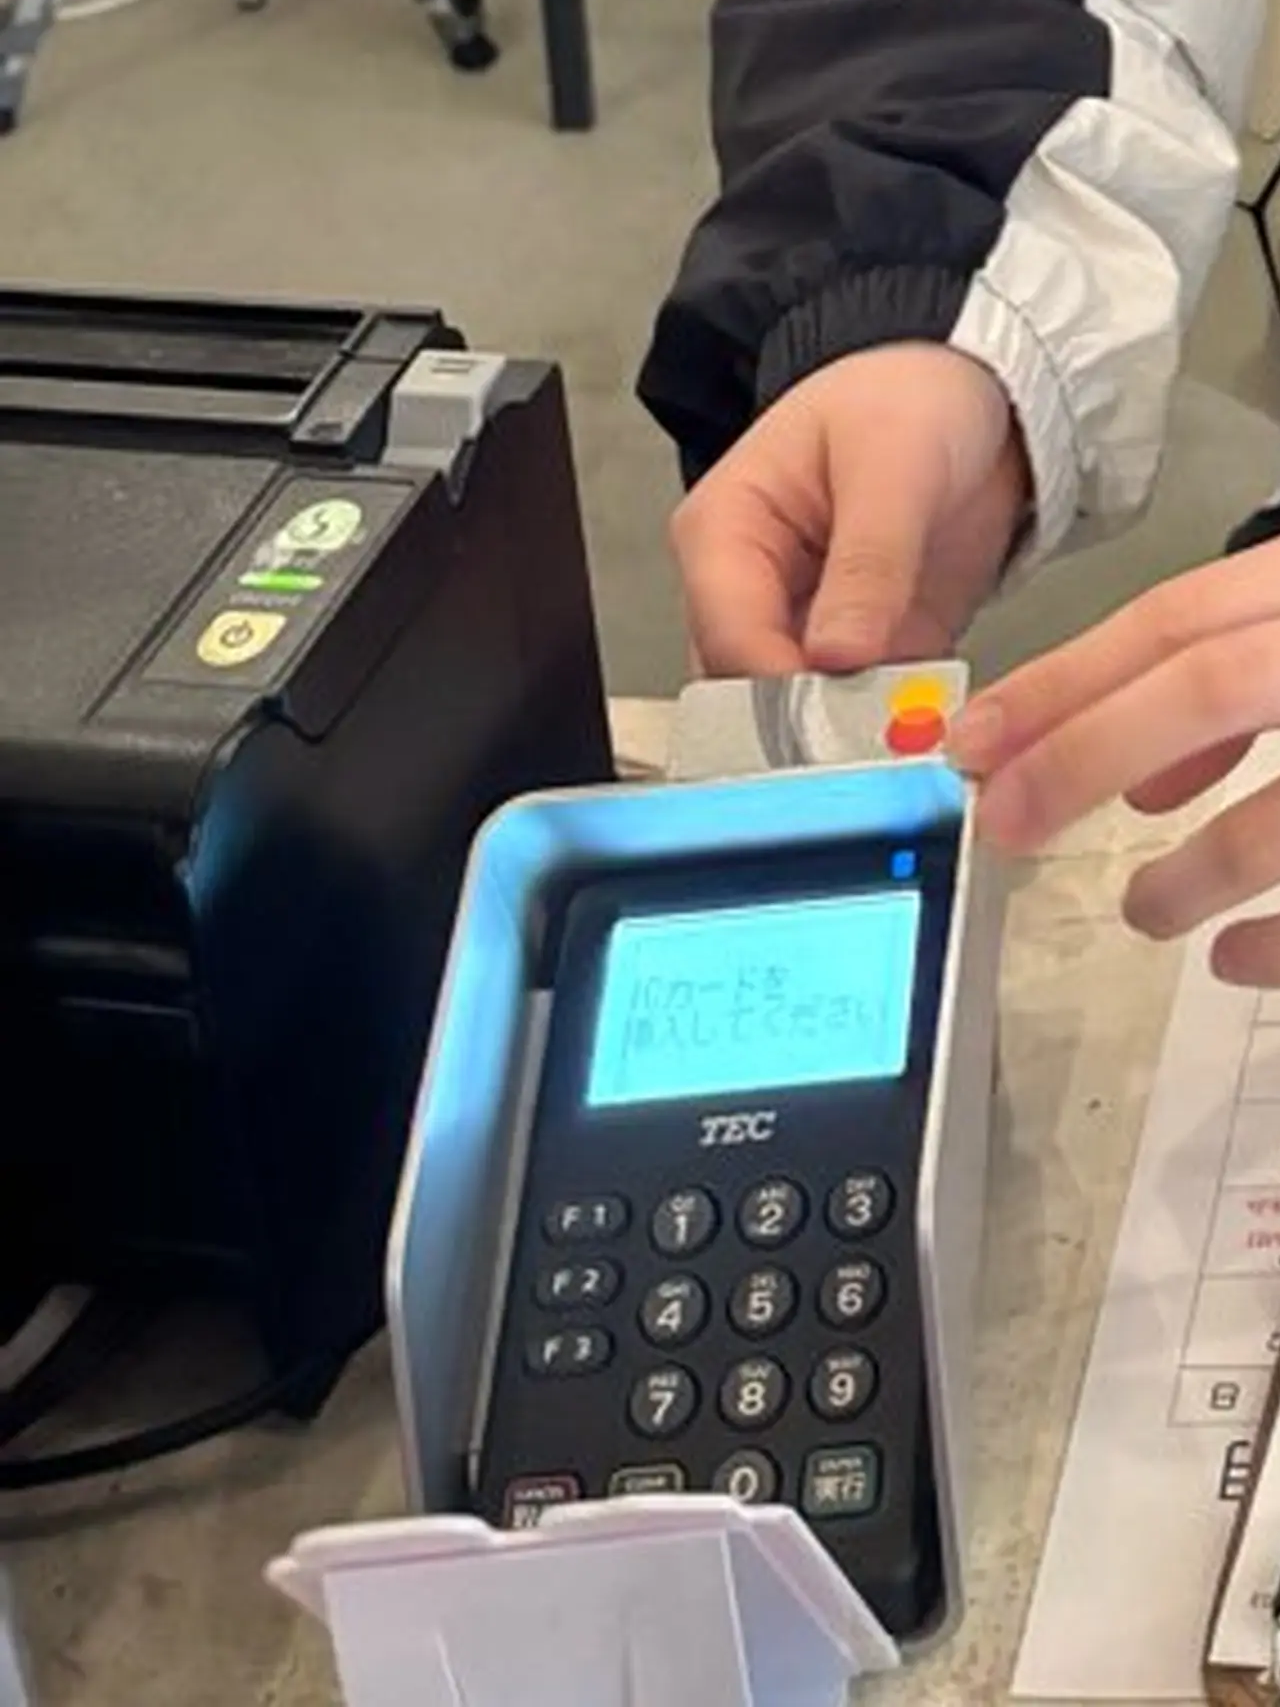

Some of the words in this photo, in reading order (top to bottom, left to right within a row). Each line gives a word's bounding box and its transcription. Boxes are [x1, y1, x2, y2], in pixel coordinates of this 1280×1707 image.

[699, 1110, 778, 1149] TEC
[756, 1202, 783, 1236] 2
[844, 1194, 873, 1227] 3
[672, 1214, 689, 1244] 1
[655, 1299, 684, 1332] 4
[747, 1291, 774, 1322] 5
[836, 1282, 864, 1316] 6
[737, 1381, 766, 1417] 8
[828, 1371, 856, 1407] 9
[1211, 1381, 1241, 1411] 日
[649, 1389, 676, 1427] 7
[728, 1466, 759, 1502] 0
[812, 1473, 867, 1504] 実行
